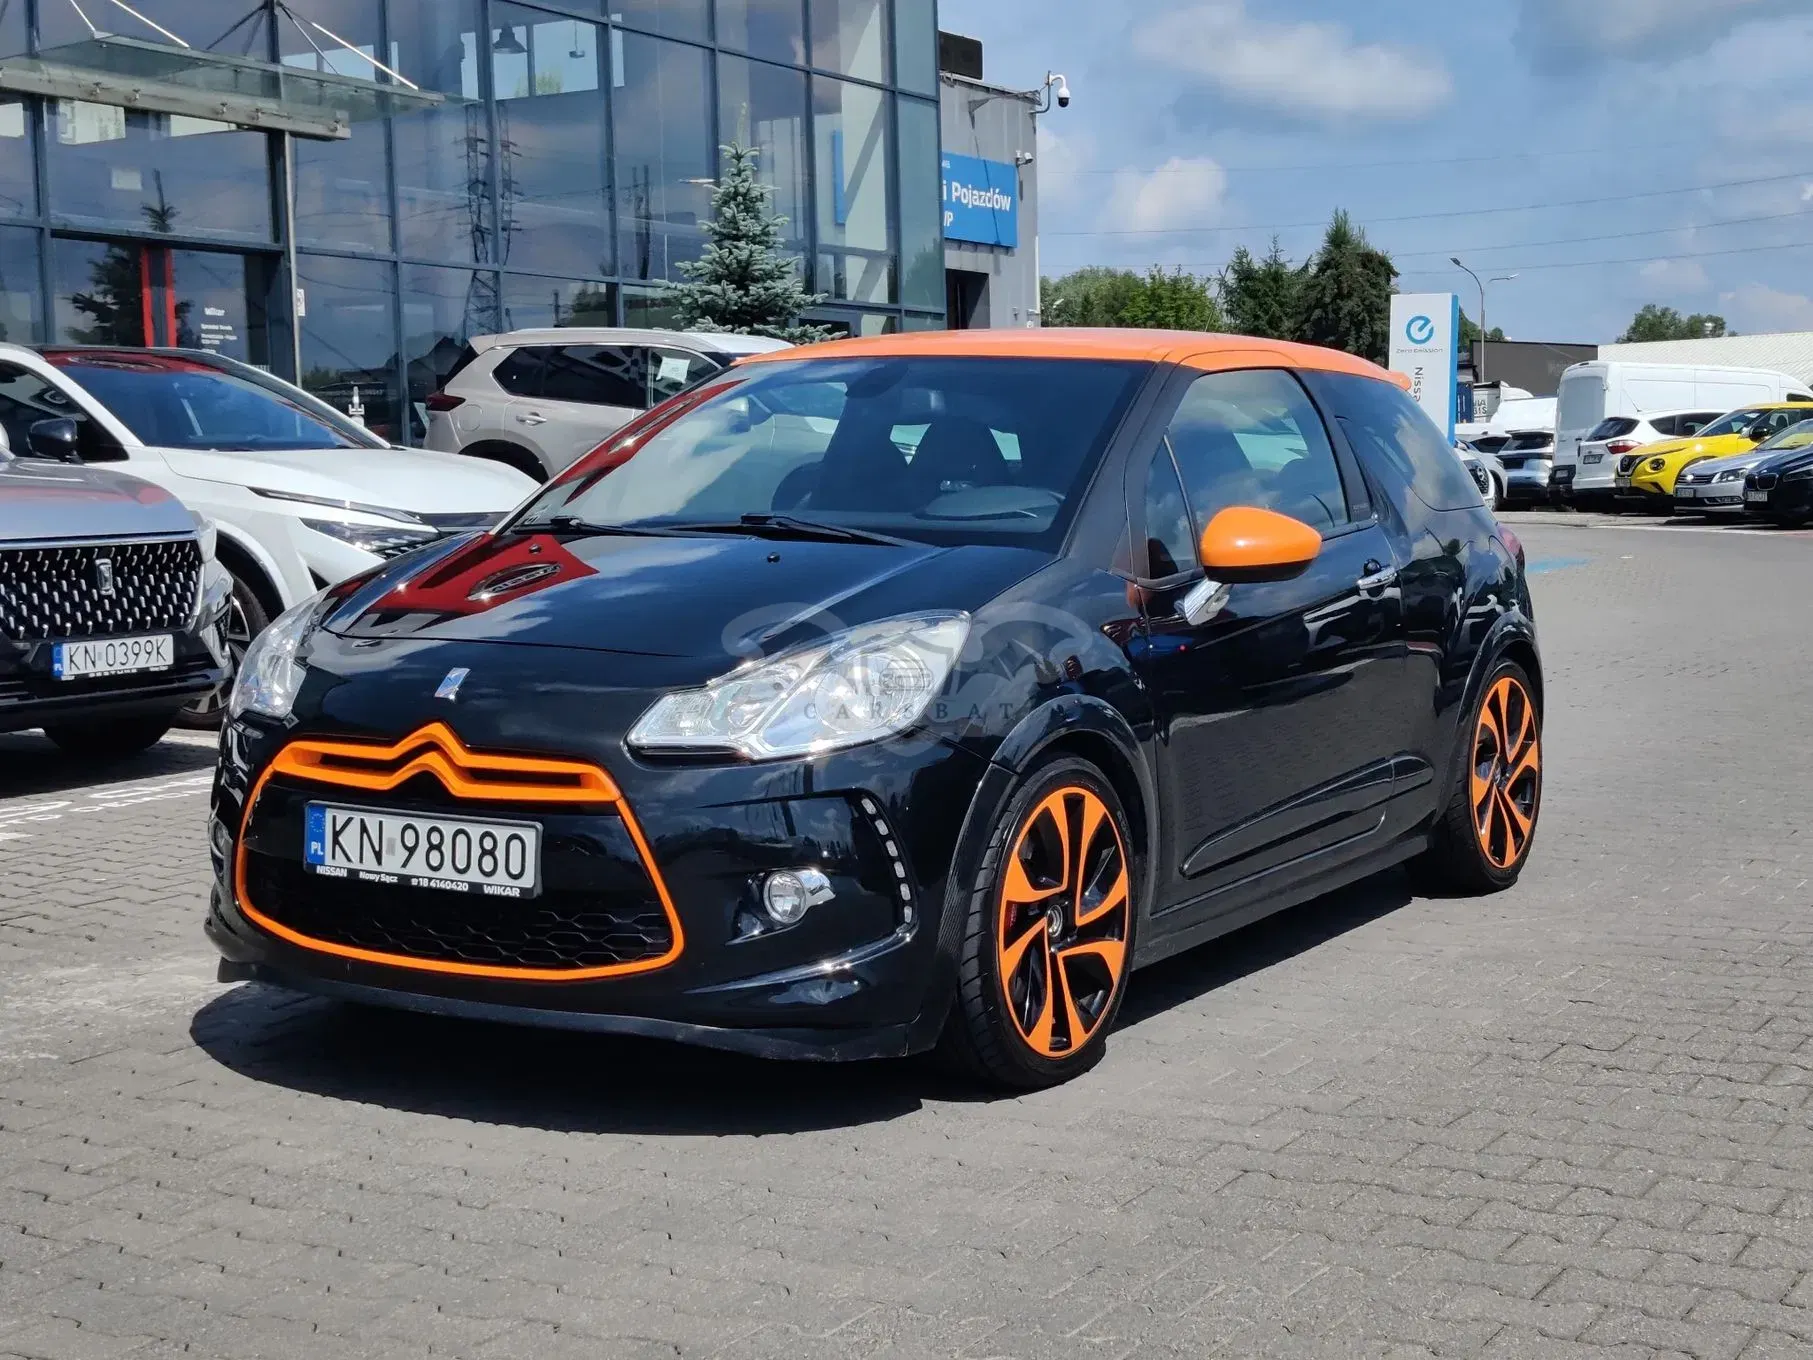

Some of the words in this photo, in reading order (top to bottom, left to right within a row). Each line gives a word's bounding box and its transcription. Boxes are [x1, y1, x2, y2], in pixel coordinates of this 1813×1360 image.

[951, 181, 1012, 212] Pojazdów
[69, 645, 96, 671] KN
[105, 638, 167, 667] 0399K
[310, 840, 324, 857] PL
[331, 814, 384, 867] KN
[400, 822, 527, 880] 98080
[316, 865, 348, 878] NISSAN
[359, 870, 380, 882] Nowy
[380, 873, 398, 884] Sącz
[429, 878, 469, 892] 4140420
[483, 884, 521, 898] WIKAR
